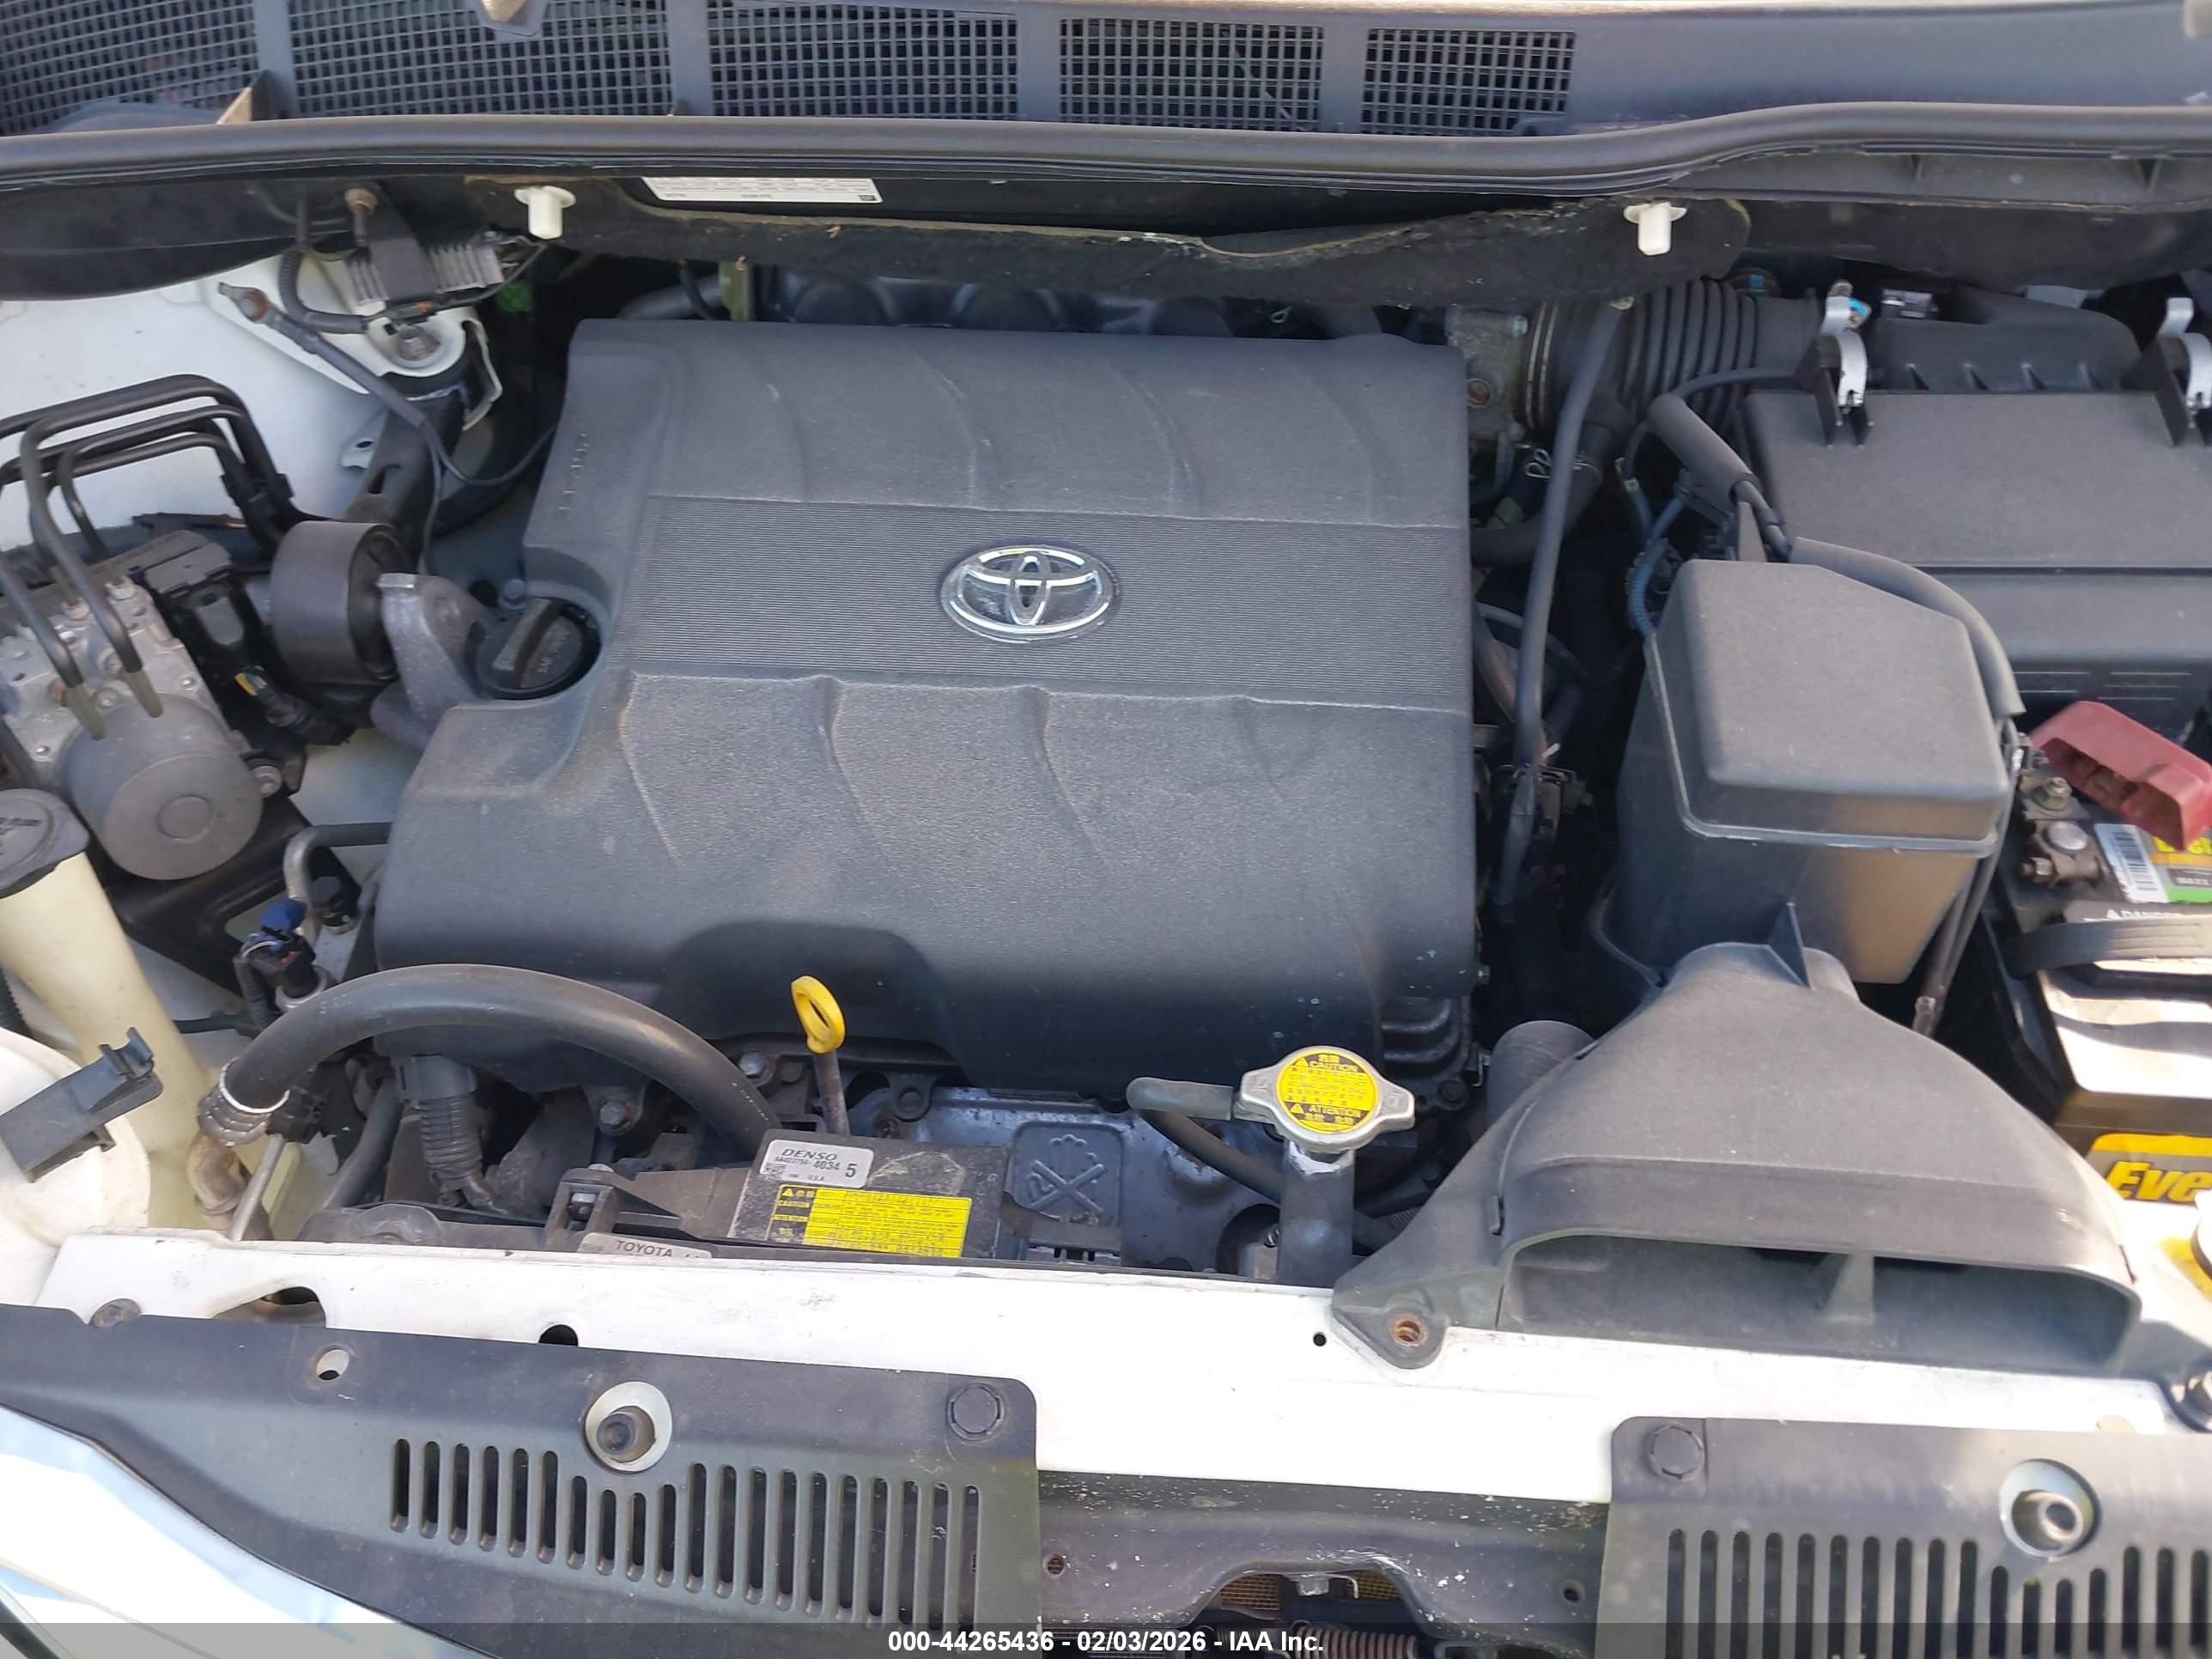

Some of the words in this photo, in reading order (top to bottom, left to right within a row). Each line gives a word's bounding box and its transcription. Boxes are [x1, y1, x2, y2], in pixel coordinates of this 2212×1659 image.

[1310, 1060, 1358, 1073] CAUTION
[1309, 1104, 1361, 1118] ATTENTION
[781, 1148, 838, 1161] DENSO
[845, 1163, 858, 1178] 5
[615, 1240, 673, 1257] TOYOTA
